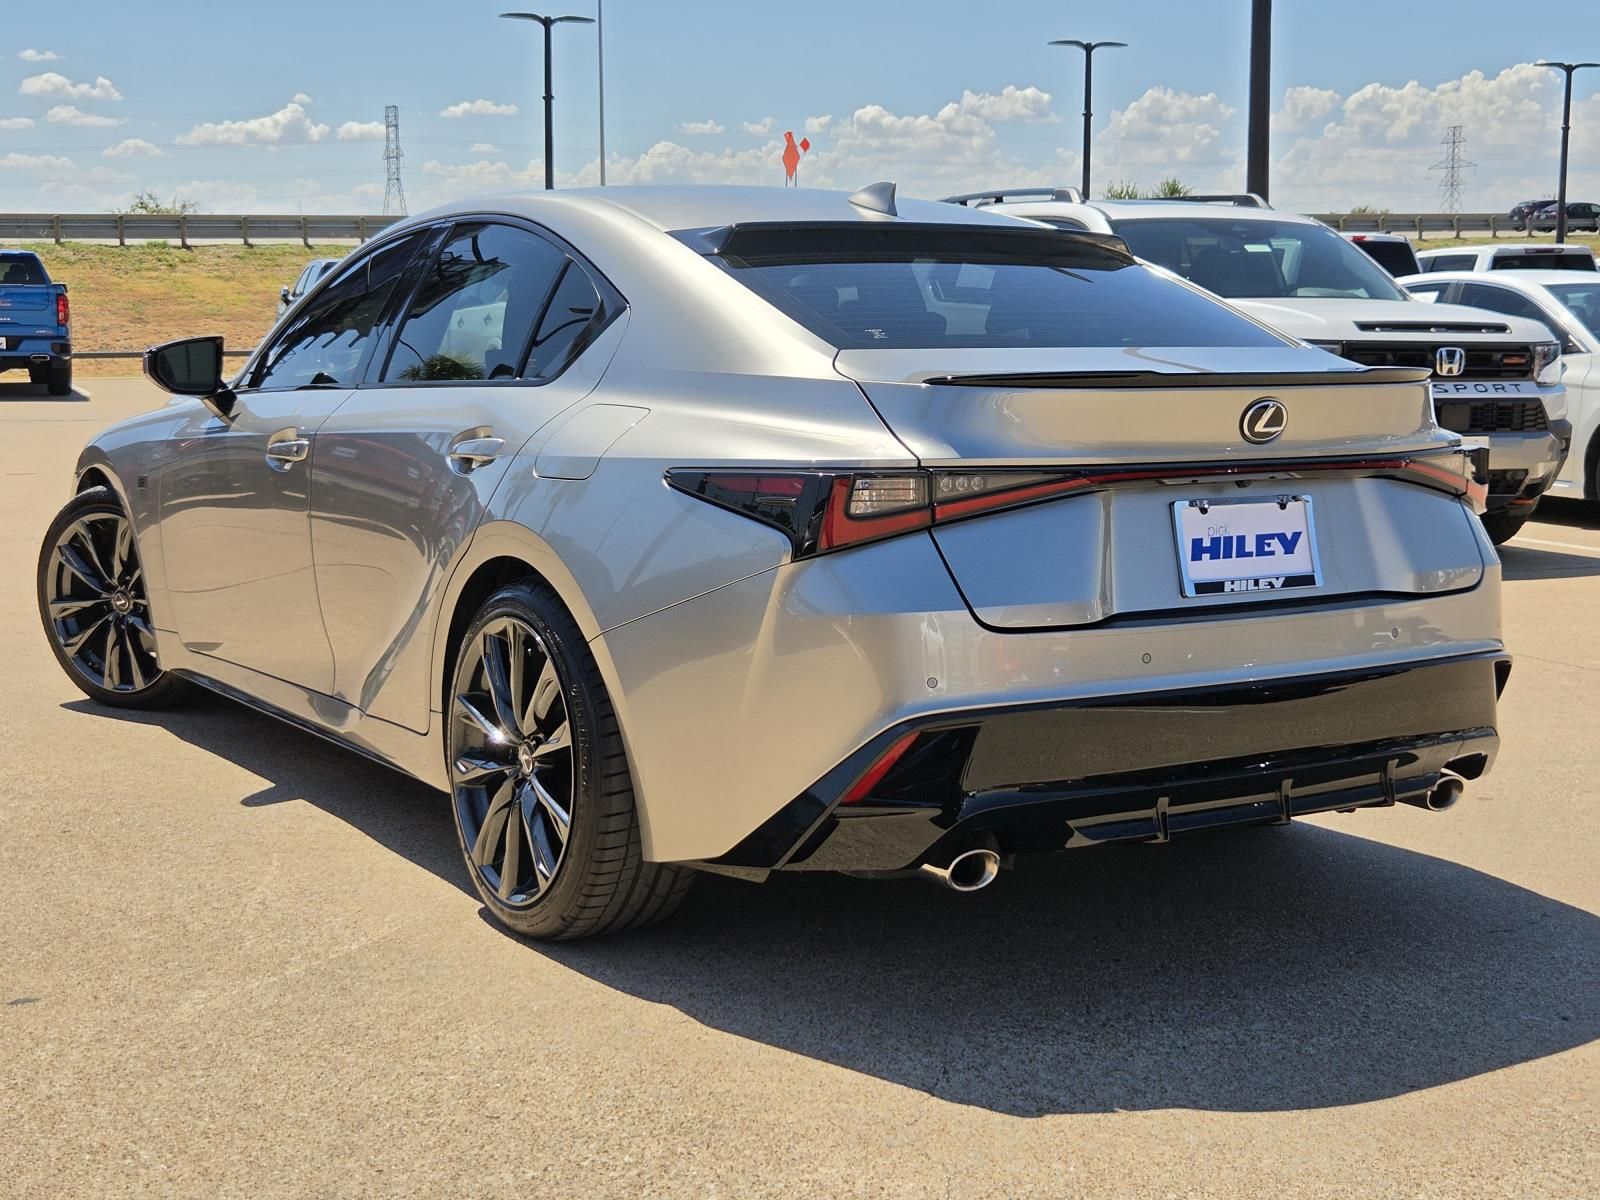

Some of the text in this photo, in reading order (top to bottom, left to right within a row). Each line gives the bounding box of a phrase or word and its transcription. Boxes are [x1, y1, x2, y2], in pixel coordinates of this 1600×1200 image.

[1433, 383, 1521, 394] SPORT
[1207, 524, 1230, 539] pick
[1190, 531, 1302, 562] HILEY
[1224, 577, 1286, 592] HILEY
